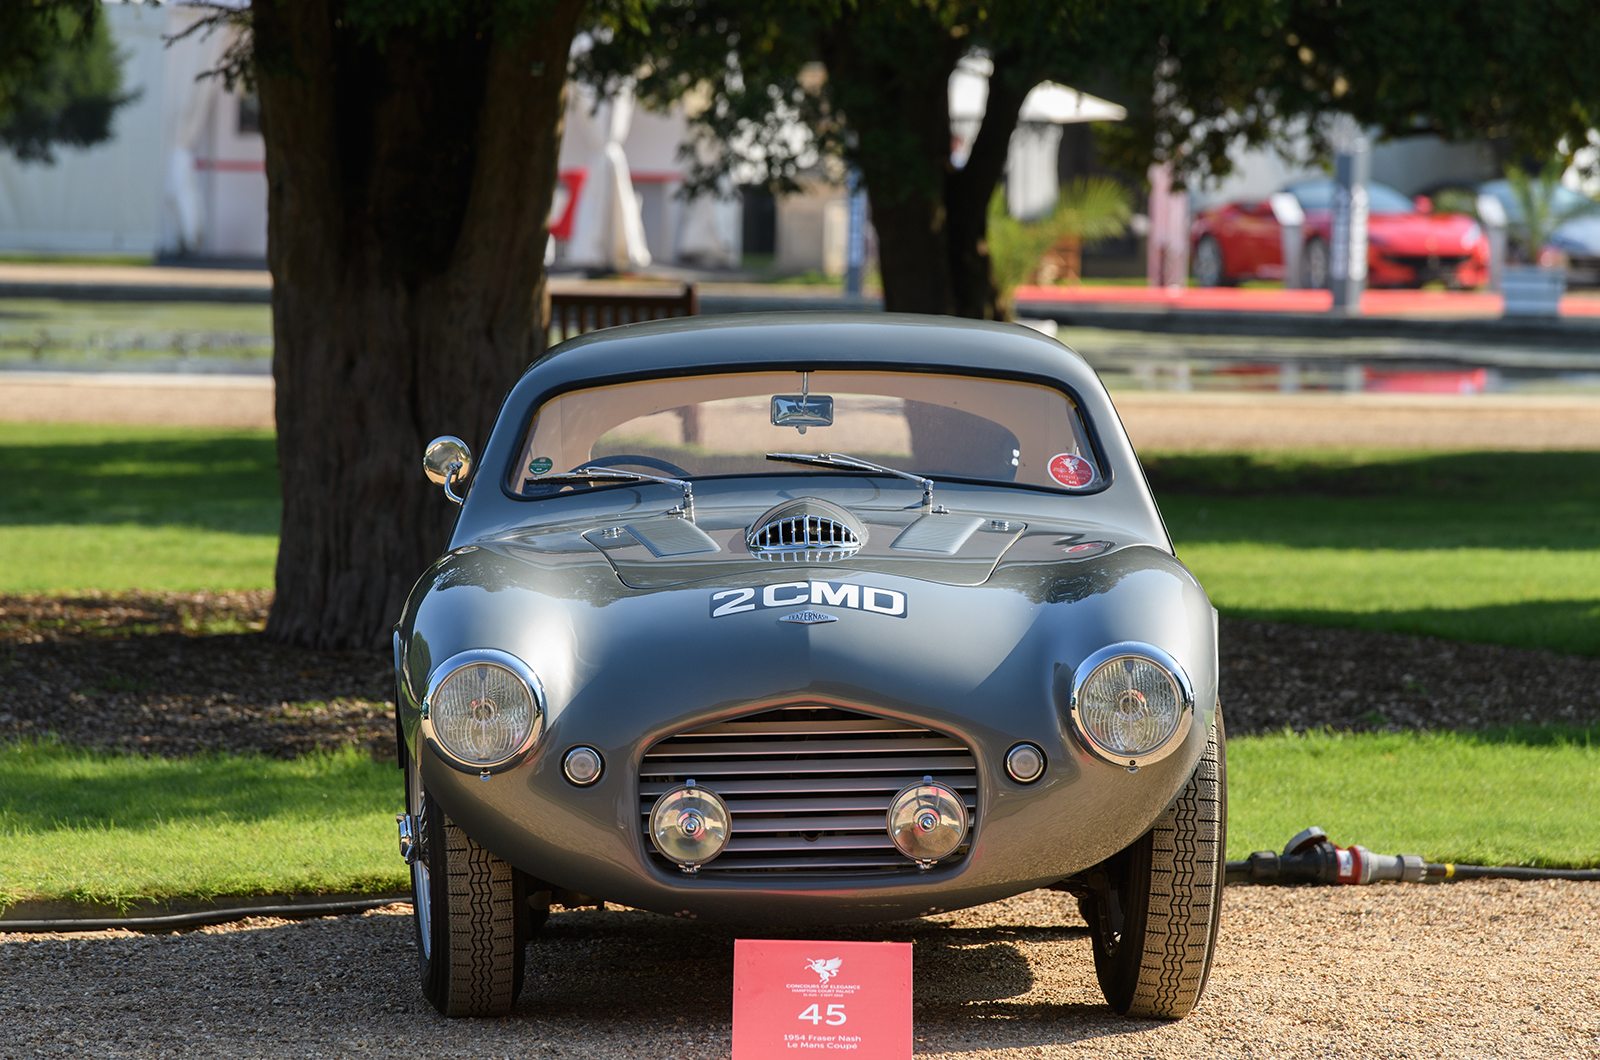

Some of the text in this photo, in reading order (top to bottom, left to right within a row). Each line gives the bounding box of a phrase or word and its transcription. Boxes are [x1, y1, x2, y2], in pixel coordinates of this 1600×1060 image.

[712, 581, 905, 617] 2 CMD
[798, 1003, 847, 1026] 45
[787, 1041, 798, 1049] Le
[826, 1042, 858, 1050] Coupé
